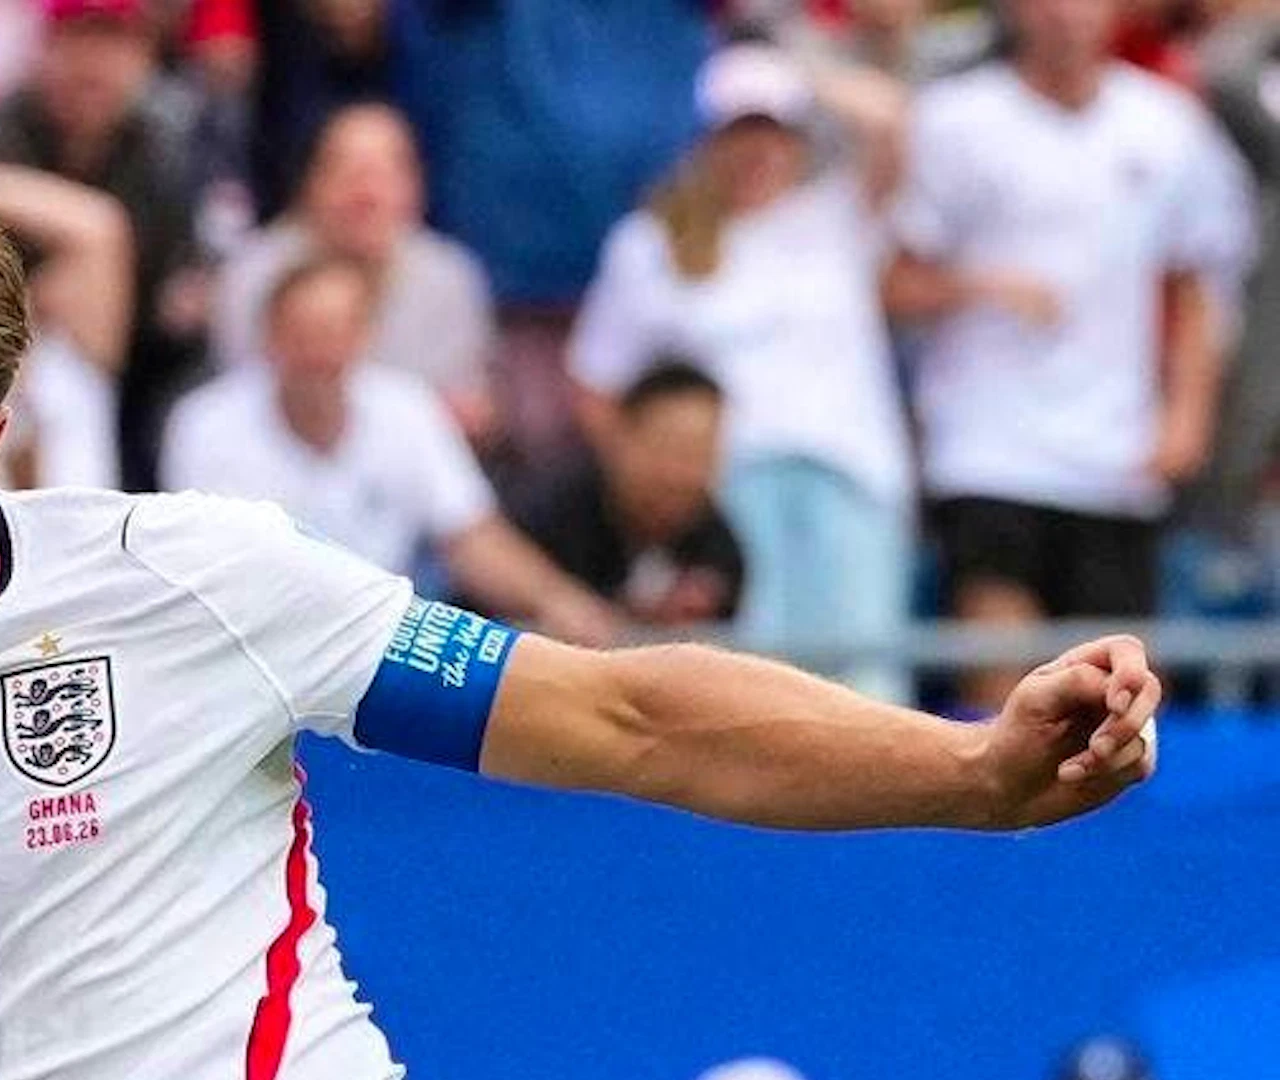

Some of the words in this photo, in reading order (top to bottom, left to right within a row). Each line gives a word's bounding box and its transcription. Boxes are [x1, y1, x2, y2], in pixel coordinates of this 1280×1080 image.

[407, 600, 462, 673] UNITE
[29, 794, 96, 820] GHANA
[27, 819, 99, 848] 23.06.26
